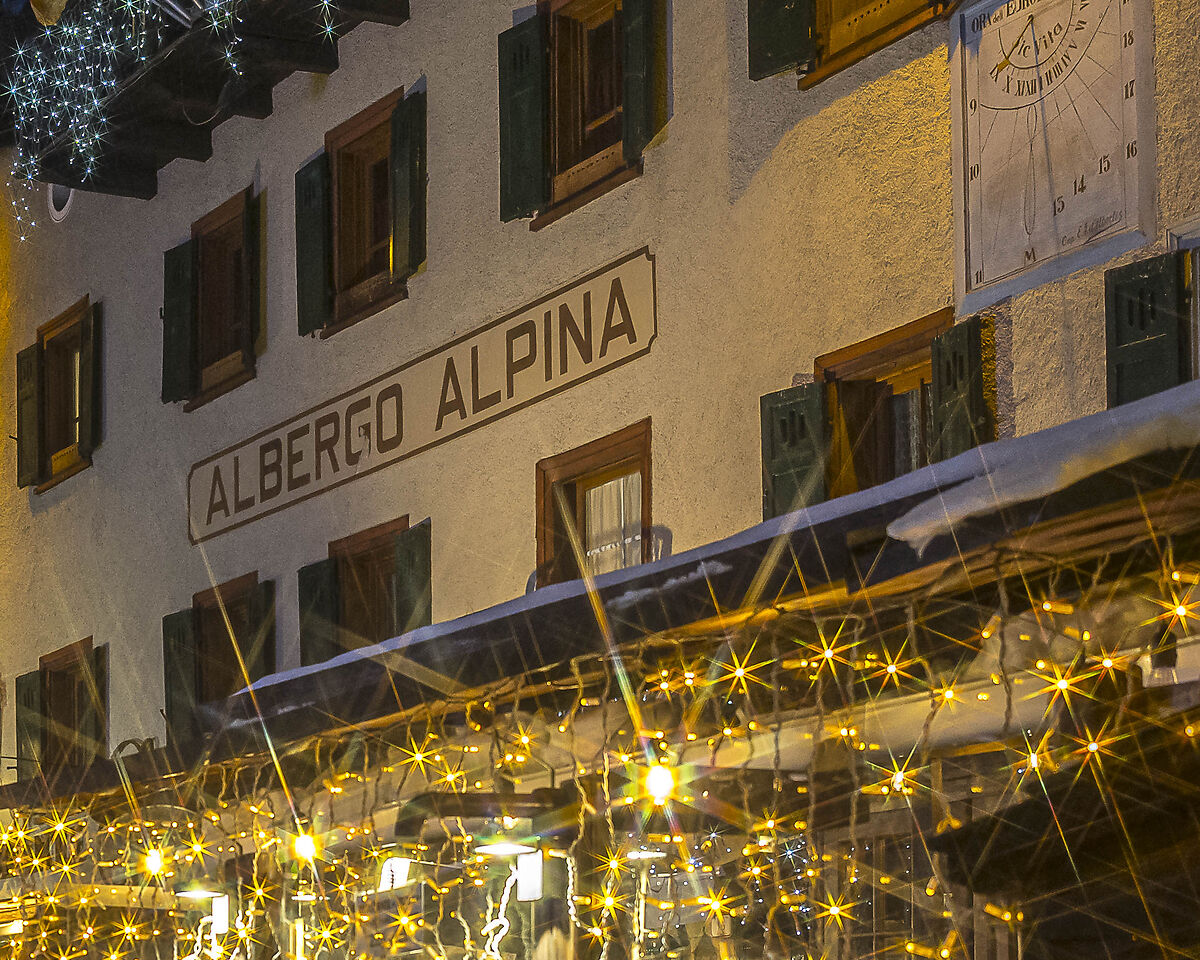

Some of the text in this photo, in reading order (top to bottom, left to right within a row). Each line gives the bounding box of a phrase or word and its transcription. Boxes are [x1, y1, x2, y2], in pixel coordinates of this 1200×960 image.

[971, 12, 991, 33] ORA
[1123, 30, 1134, 48] 18
[1124, 79, 1135, 99] 17
[969, 98, 977, 116] 9
[1125, 140, 1138, 160] 16
[969, 163, 980, 182] 10
[1097, 154, 1111, 175] 15
[1072, 174, 1086, 196] 14
[1023, 247, 1037, 262] M
[206, 277, 637, 526] ALBERGO ALPINA
